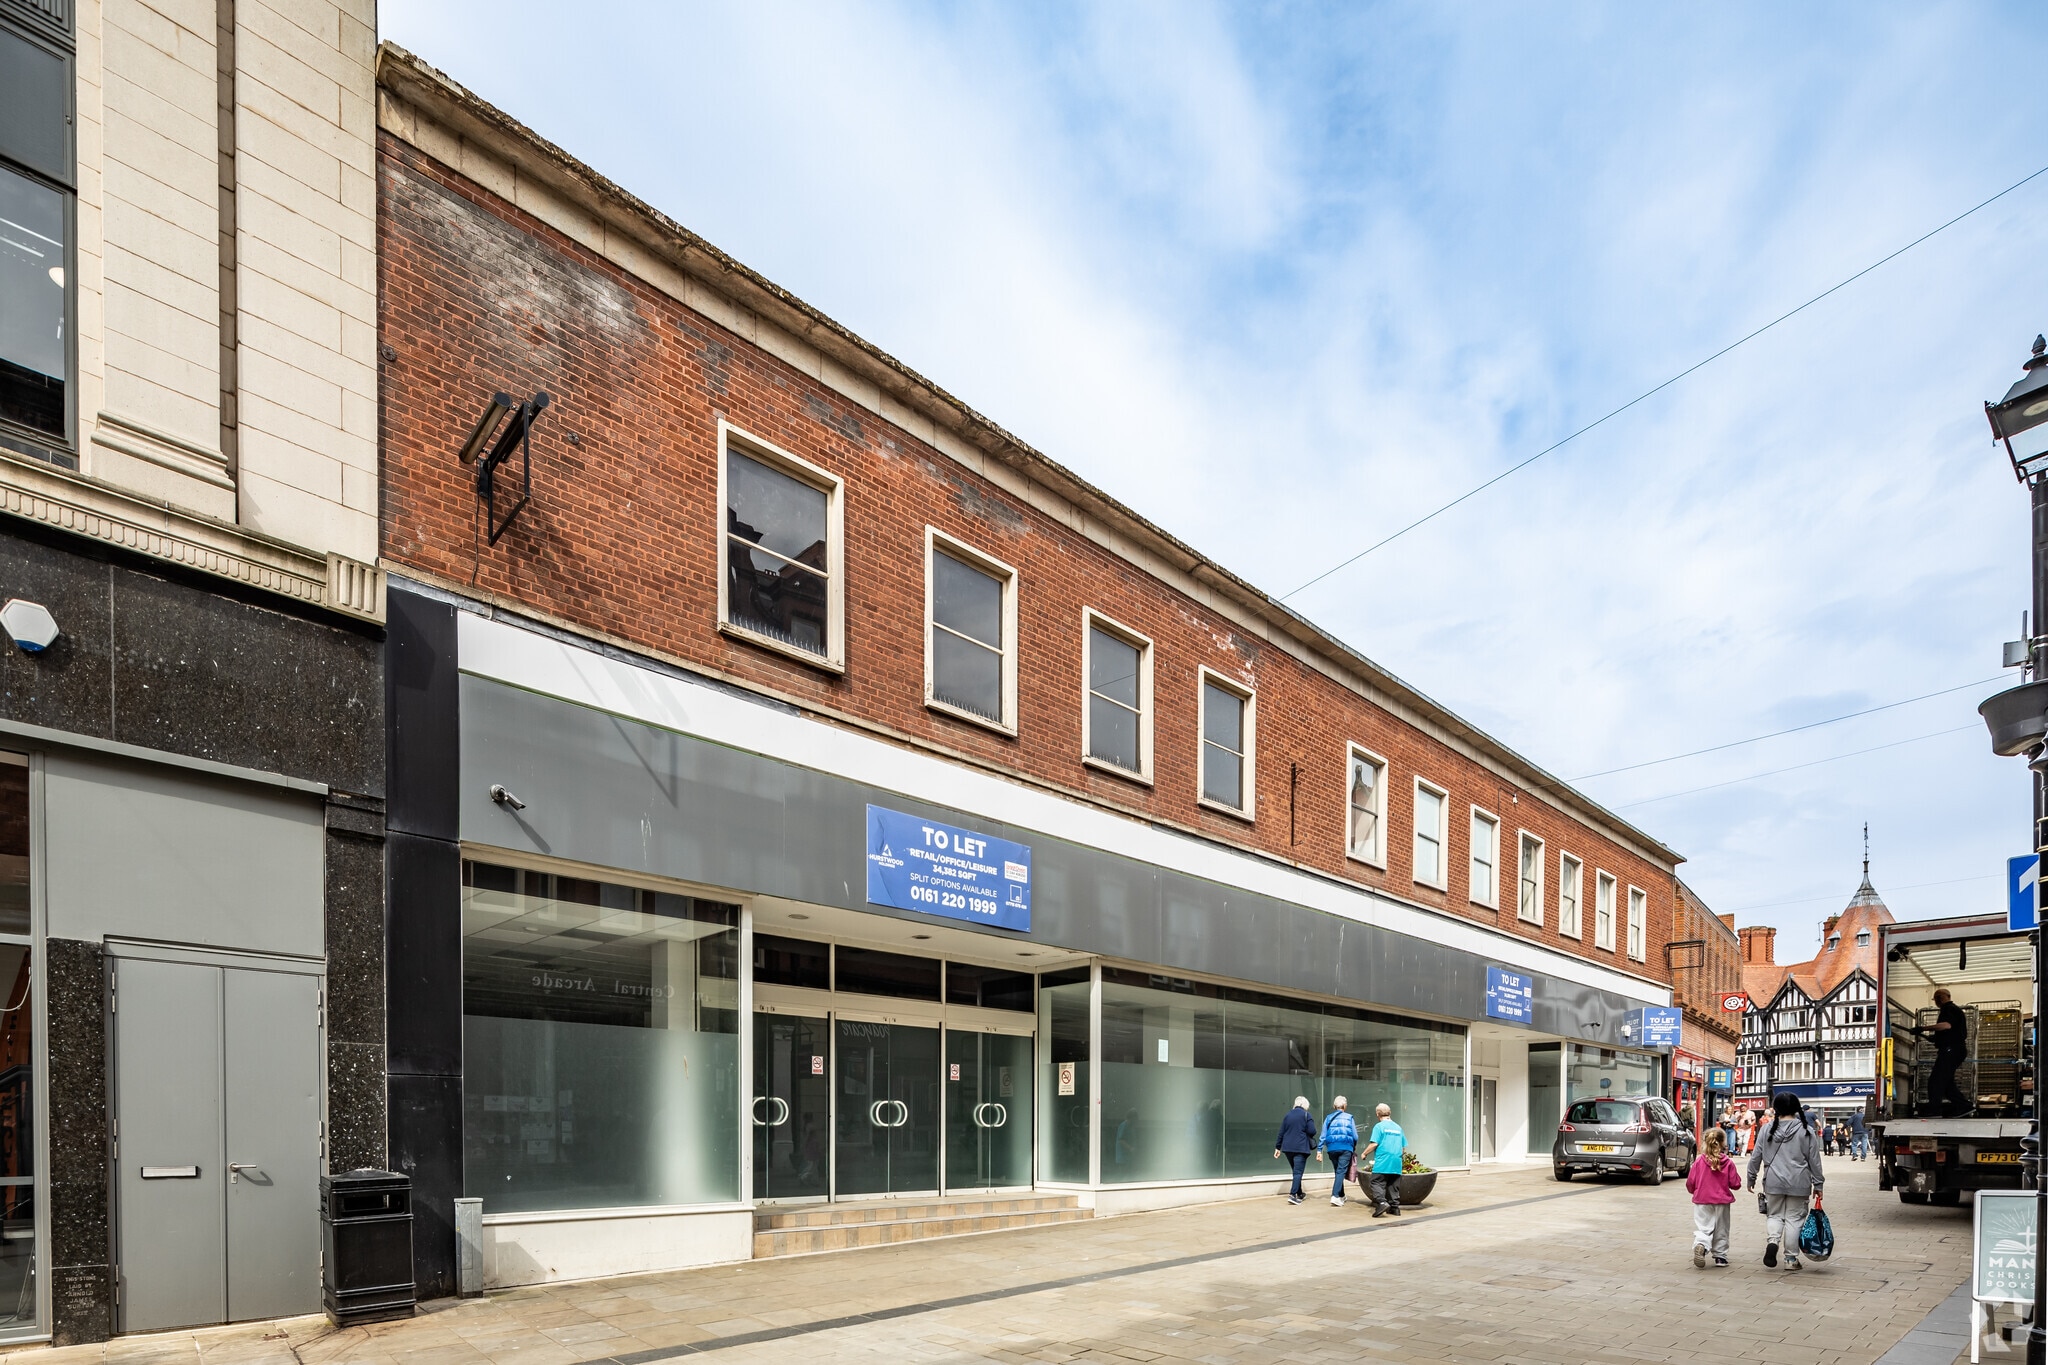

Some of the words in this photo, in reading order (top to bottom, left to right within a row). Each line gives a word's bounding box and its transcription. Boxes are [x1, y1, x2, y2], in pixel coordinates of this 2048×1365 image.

[922, 827, 948, 849] TO
[954, 835, 986, 858] LET
[869, 853, 904, 866] HURSTWOOD
[910, 848, 998, 875] RETAIL/OFFICE/LEISURE
[958, 870, 976, 881] SQFT
[910, 872, 929, 883] SPLIT
[931, 877, 960, 890] OPTIONS
[962, 884, 998, 898] AVAILABLE
[911, 886, 938, 904] 0161
[942, 892, 966, 908] 220
[968, 898, 996, 914] 1999
[1502, 974, 1510, 984] TO
[1510, 976, 1520, 987] LET
[1989, 1256, 2035, 1269] MAN
[1988, 1271, 2034, 1280] CHRIS
[1986, 1280, 2035, 1289] BOOKS
